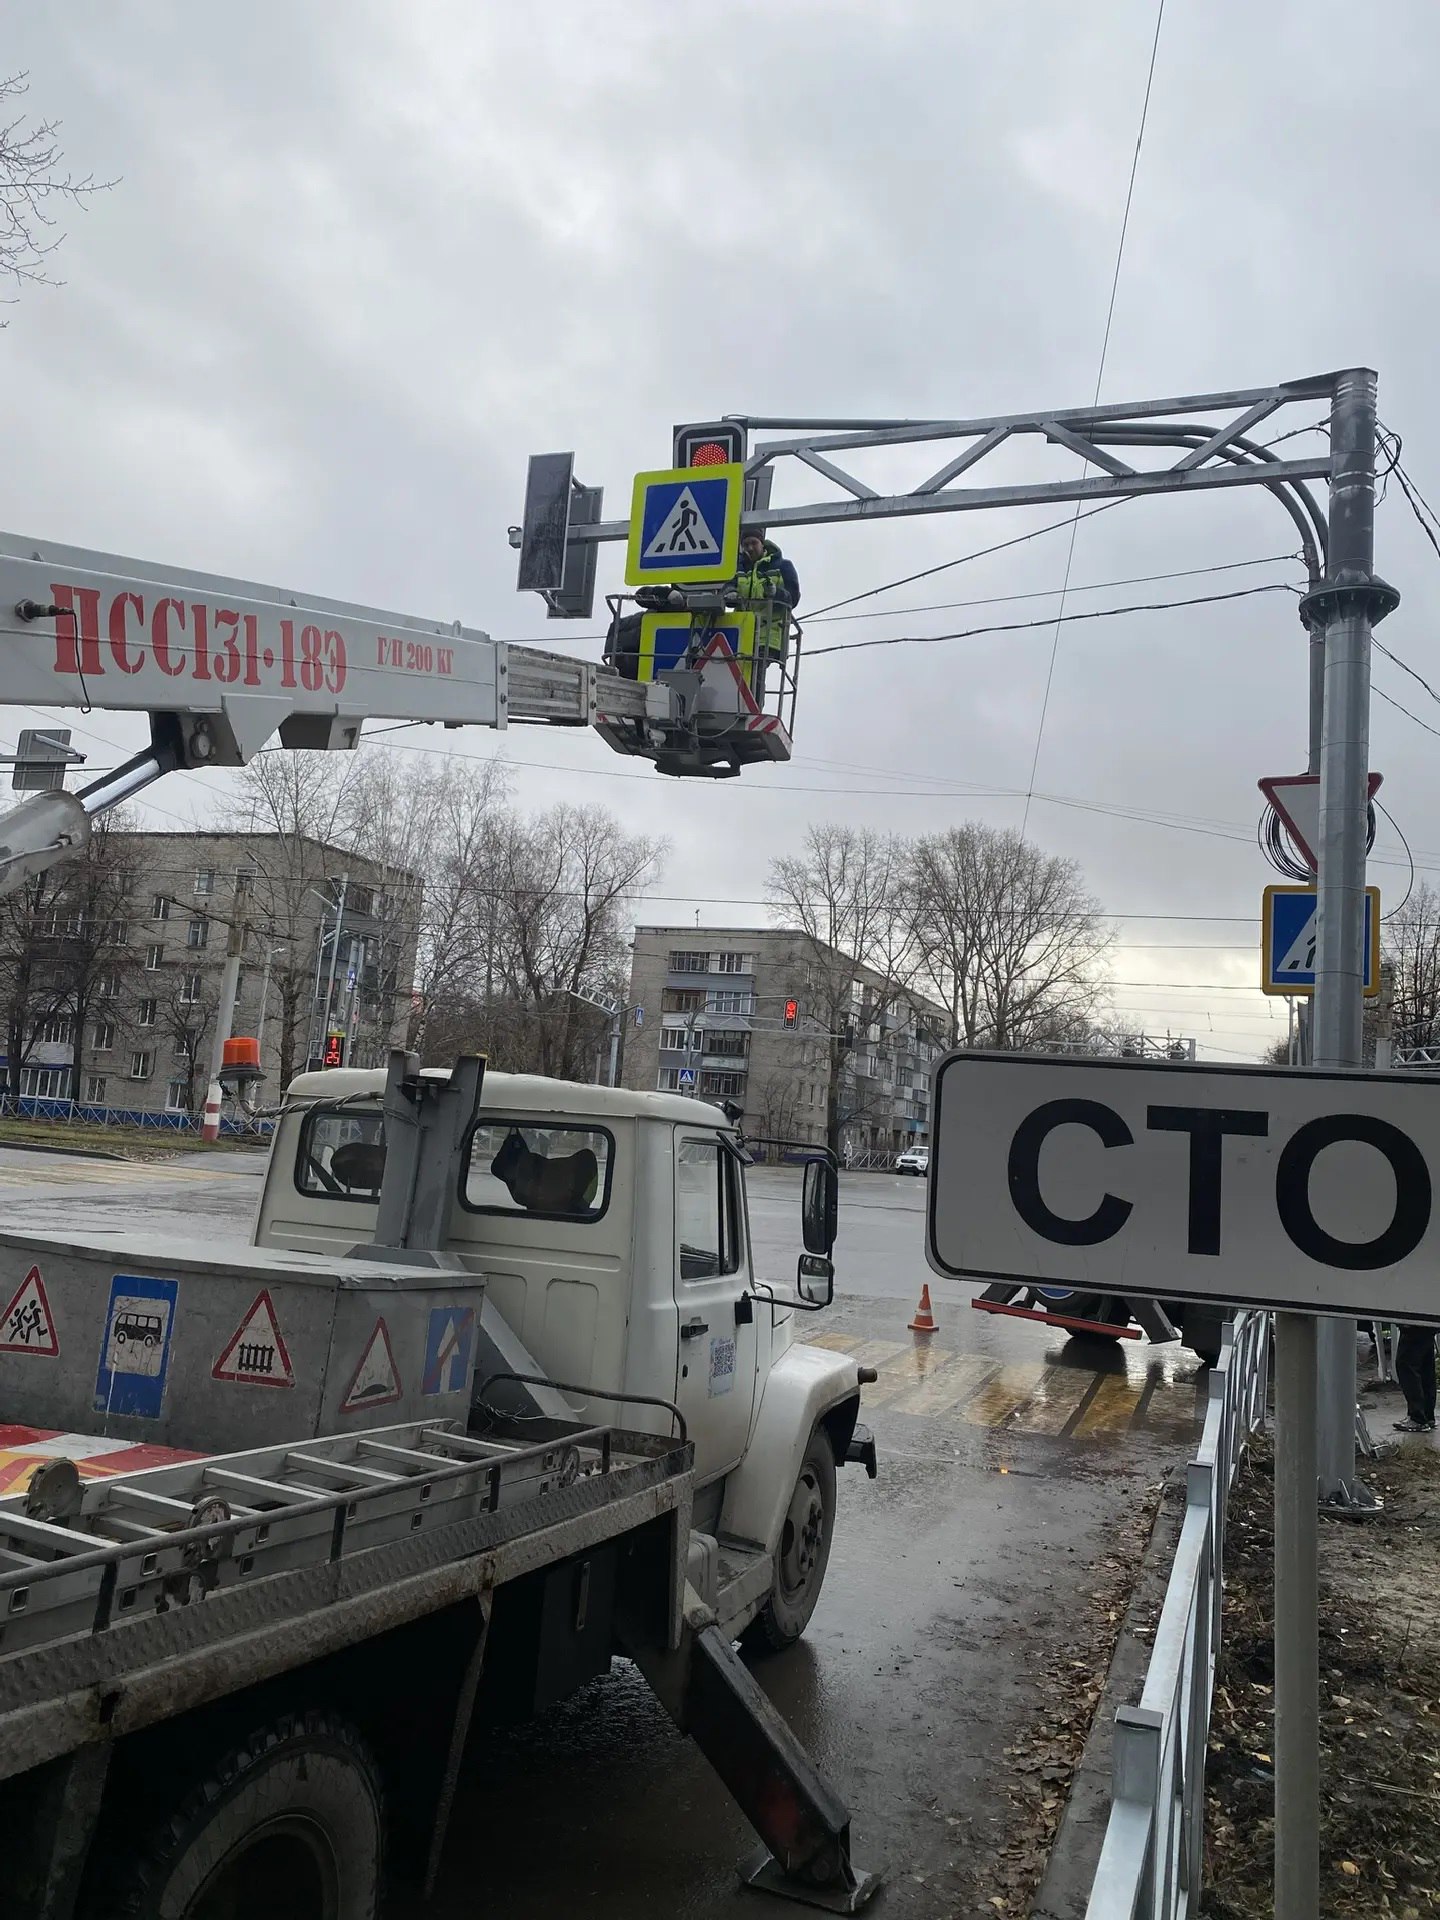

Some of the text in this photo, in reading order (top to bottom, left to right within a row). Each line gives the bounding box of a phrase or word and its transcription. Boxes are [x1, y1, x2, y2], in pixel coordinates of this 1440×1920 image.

[377, 636, 454, 674] Г/П 200 КГ
[1008, 1098, 1432, 1270] СТО
